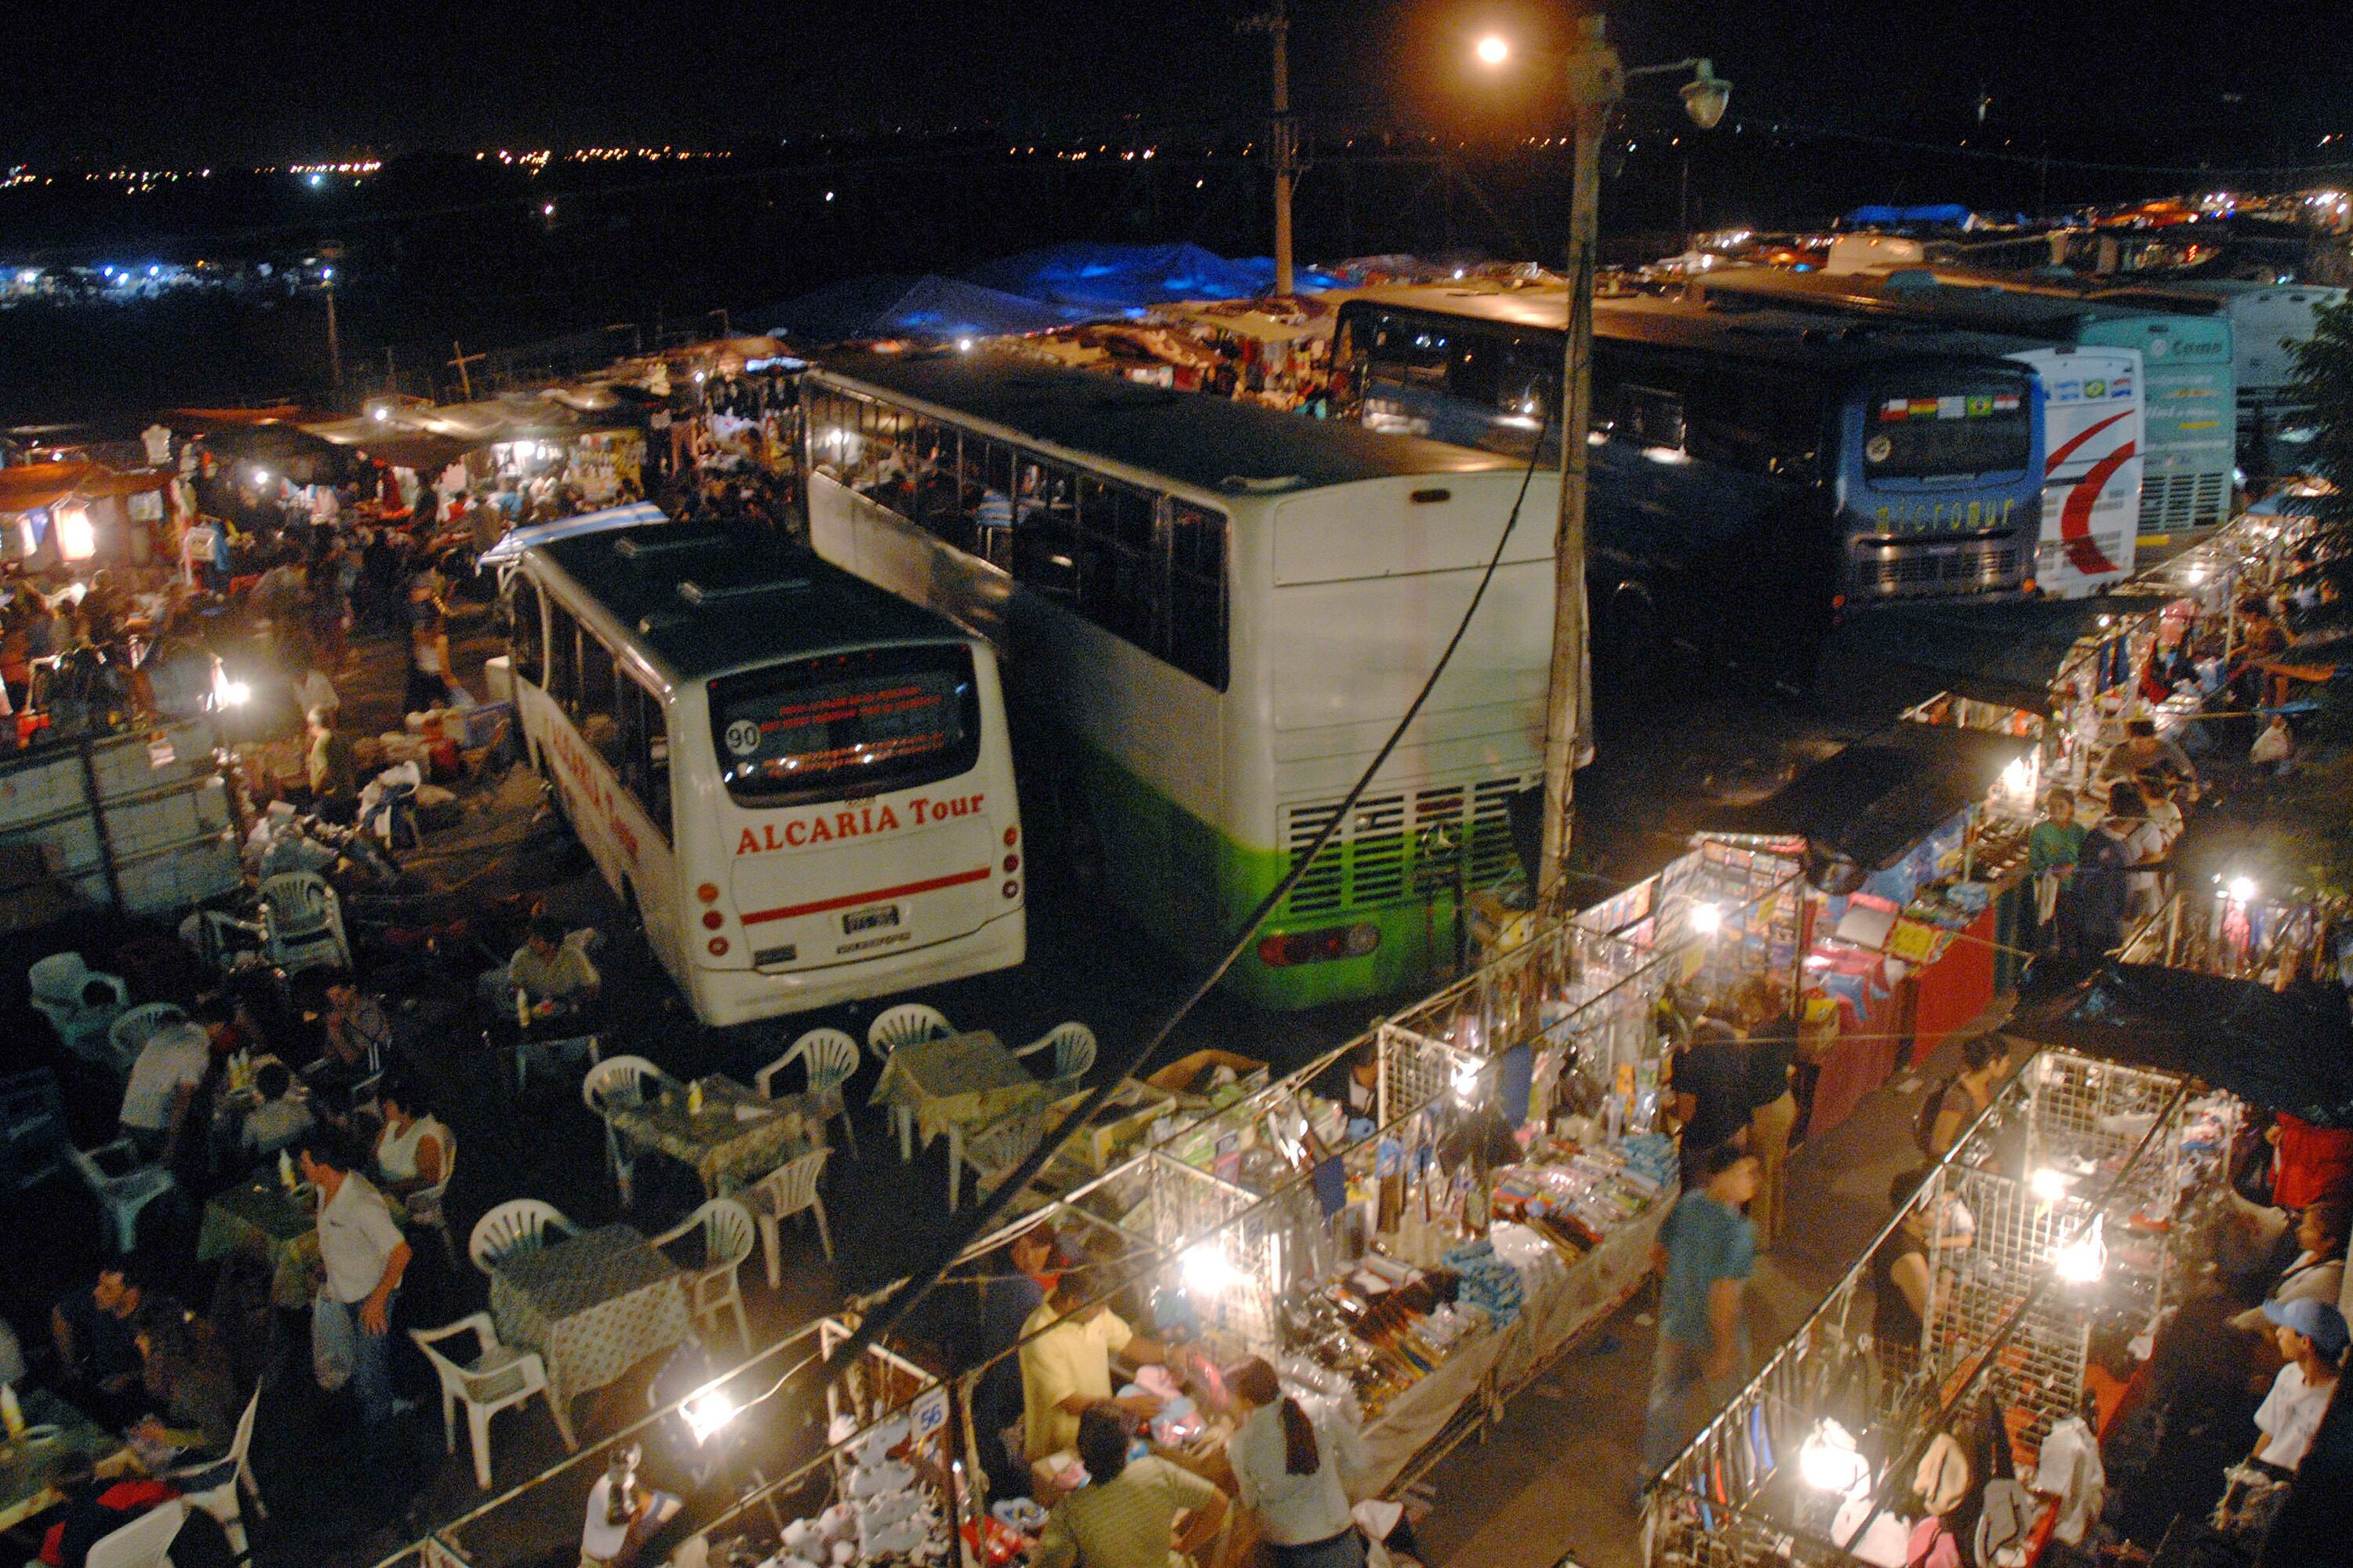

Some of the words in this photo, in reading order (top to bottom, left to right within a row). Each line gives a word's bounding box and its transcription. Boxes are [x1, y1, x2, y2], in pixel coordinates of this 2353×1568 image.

[728, 726, 757, 748] 90
[736, 804, 900, 856] ALCARIA
[910, 792, 985, 826] Tour
